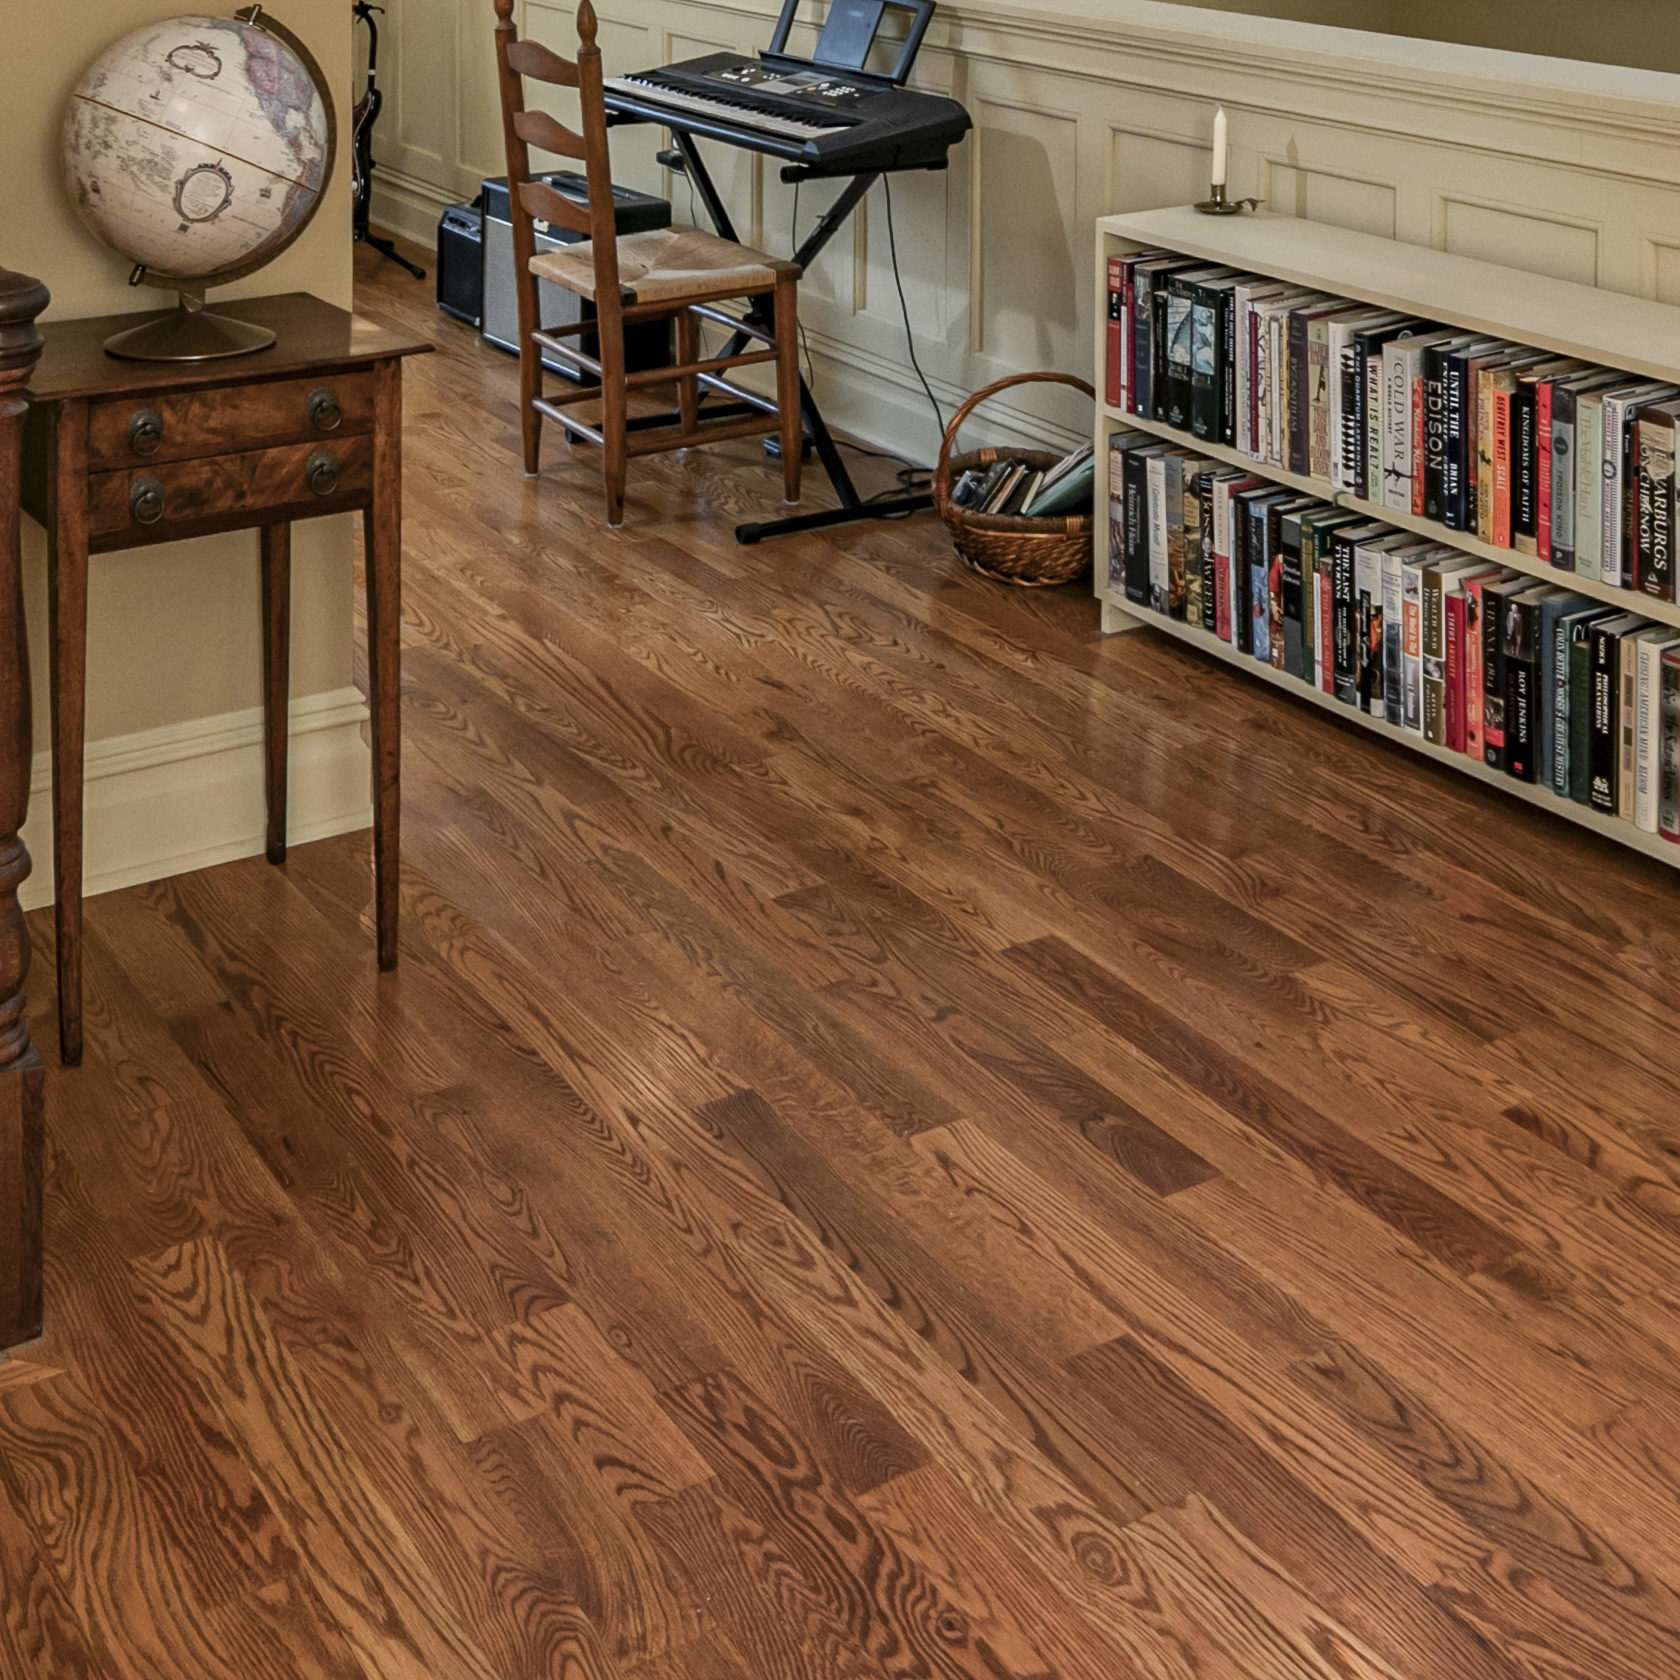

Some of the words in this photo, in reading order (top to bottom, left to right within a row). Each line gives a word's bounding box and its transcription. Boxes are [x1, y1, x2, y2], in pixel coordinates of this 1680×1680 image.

[1369, 365, 1378, 403] WHAT
[1394, 362, 1404, 413] COLD
[1449, 371, 1459, 410] UNTIL
[1369, 409, 1378, 421] IS
[1428, 381, 1442, 470] EDISON
[1449, 412, 1459, 438] THE
[1497, 396, 1505, 437] GEOFFREY
[1369, 427, 1378, 470] REAL?
[1394, 421, 1404, 459] WAR
[1497, 439, 1505, 461] WEST
[1522, 406, 1530, 466] KINGDOMS
[1449, 463, 1458, 495] BRIAN
[1497, 465, 1505, 490] SCALE
[1522, 470, 1530, 485] OF
[1522, 488, 1530, 522] FAITH
[1640, 471, 1651, 553] CHERNOW
[1342, 546, 1350, 572] THE
[1342, 574, 1350, 602] LAST
[1518, 670, 1526, 693] ROY
